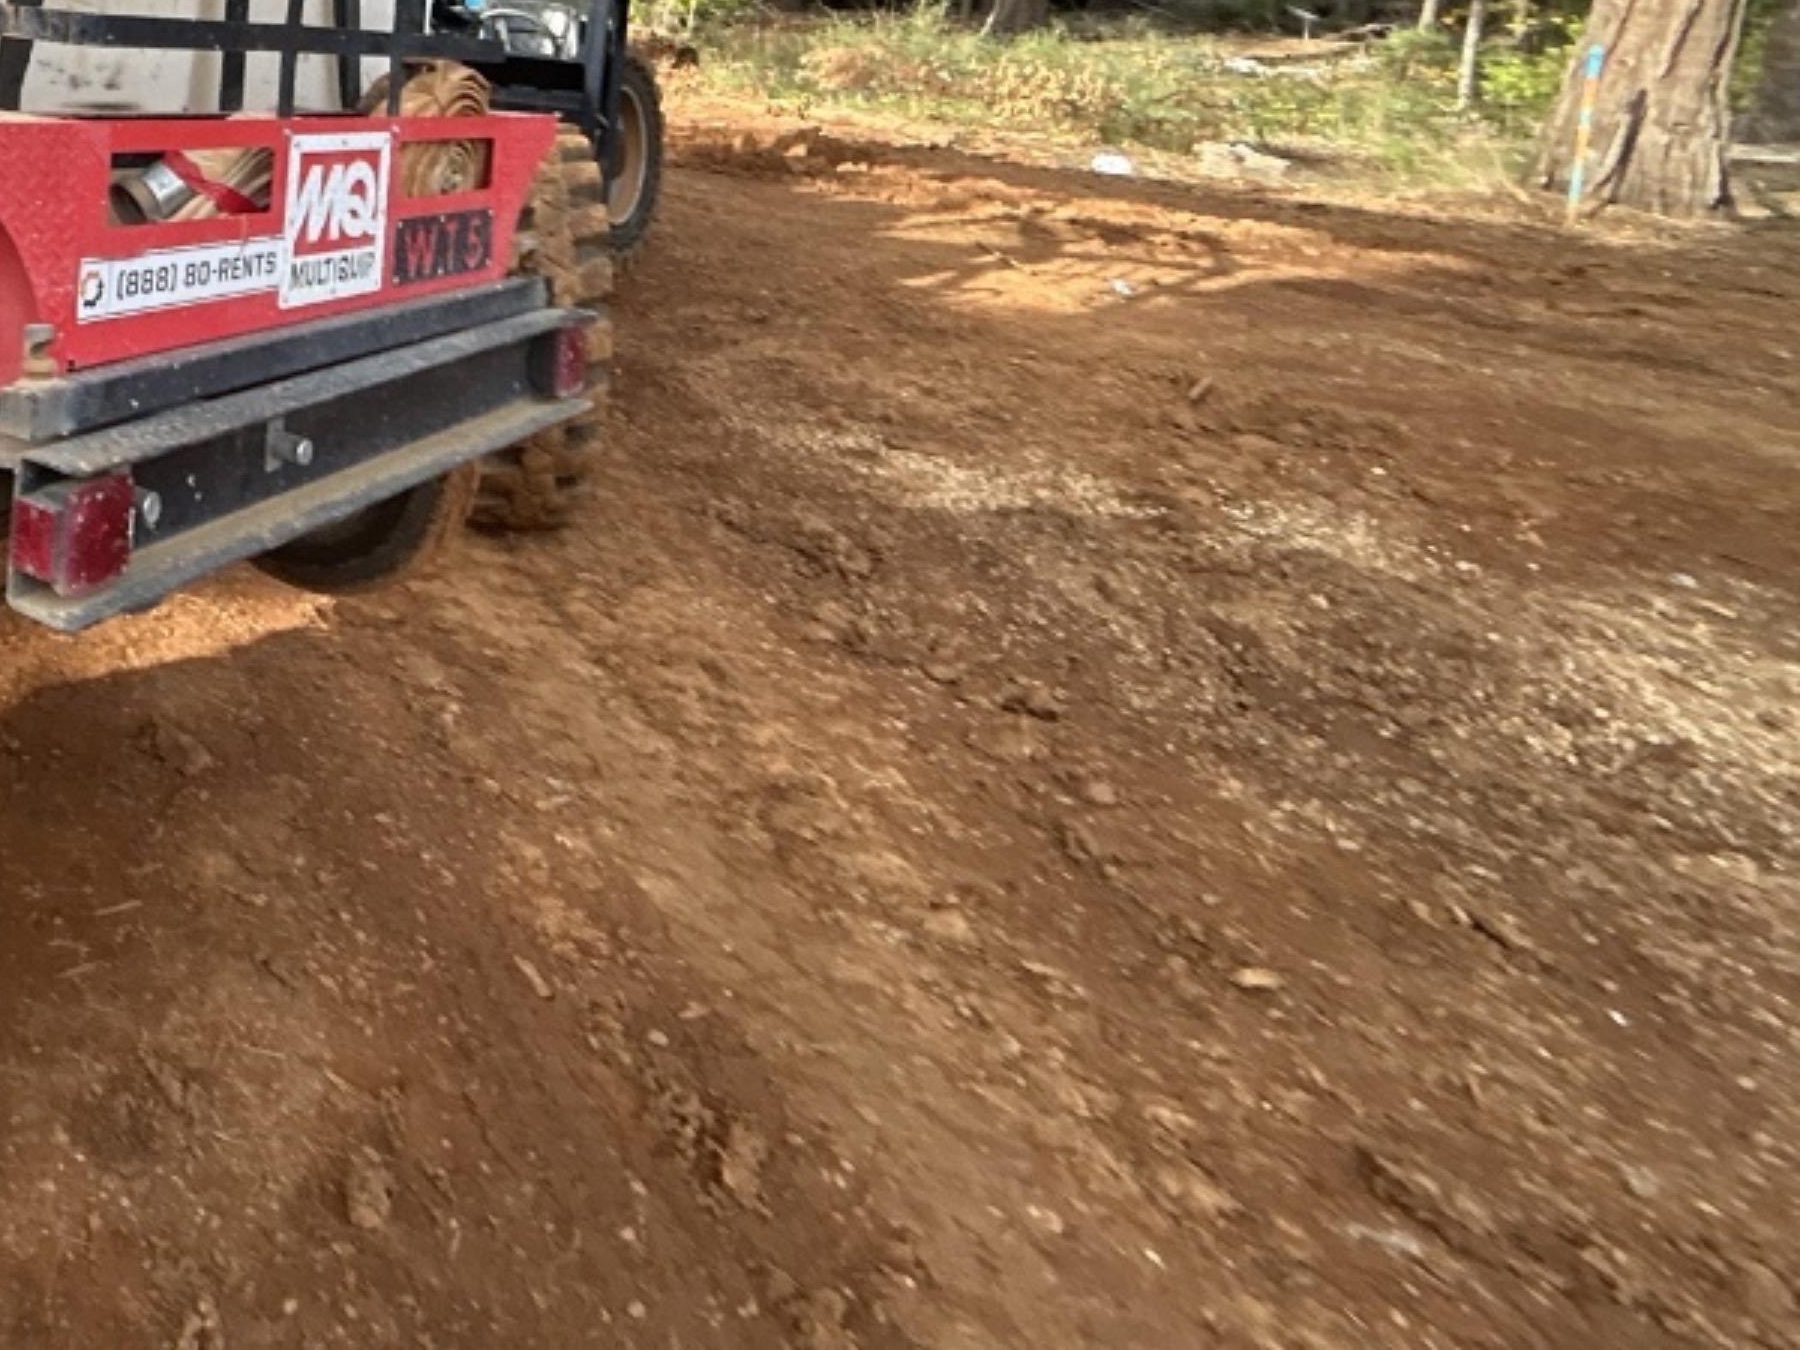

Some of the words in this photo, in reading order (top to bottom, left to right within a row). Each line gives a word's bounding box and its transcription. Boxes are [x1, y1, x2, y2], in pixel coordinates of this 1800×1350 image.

[288, 160, 378, 243] MQ
[116, 263, 178, 300] (888)
[183, 251, 277, 288] 80-RENTS
[288, 251, 376, 290] MULTIQUIP
